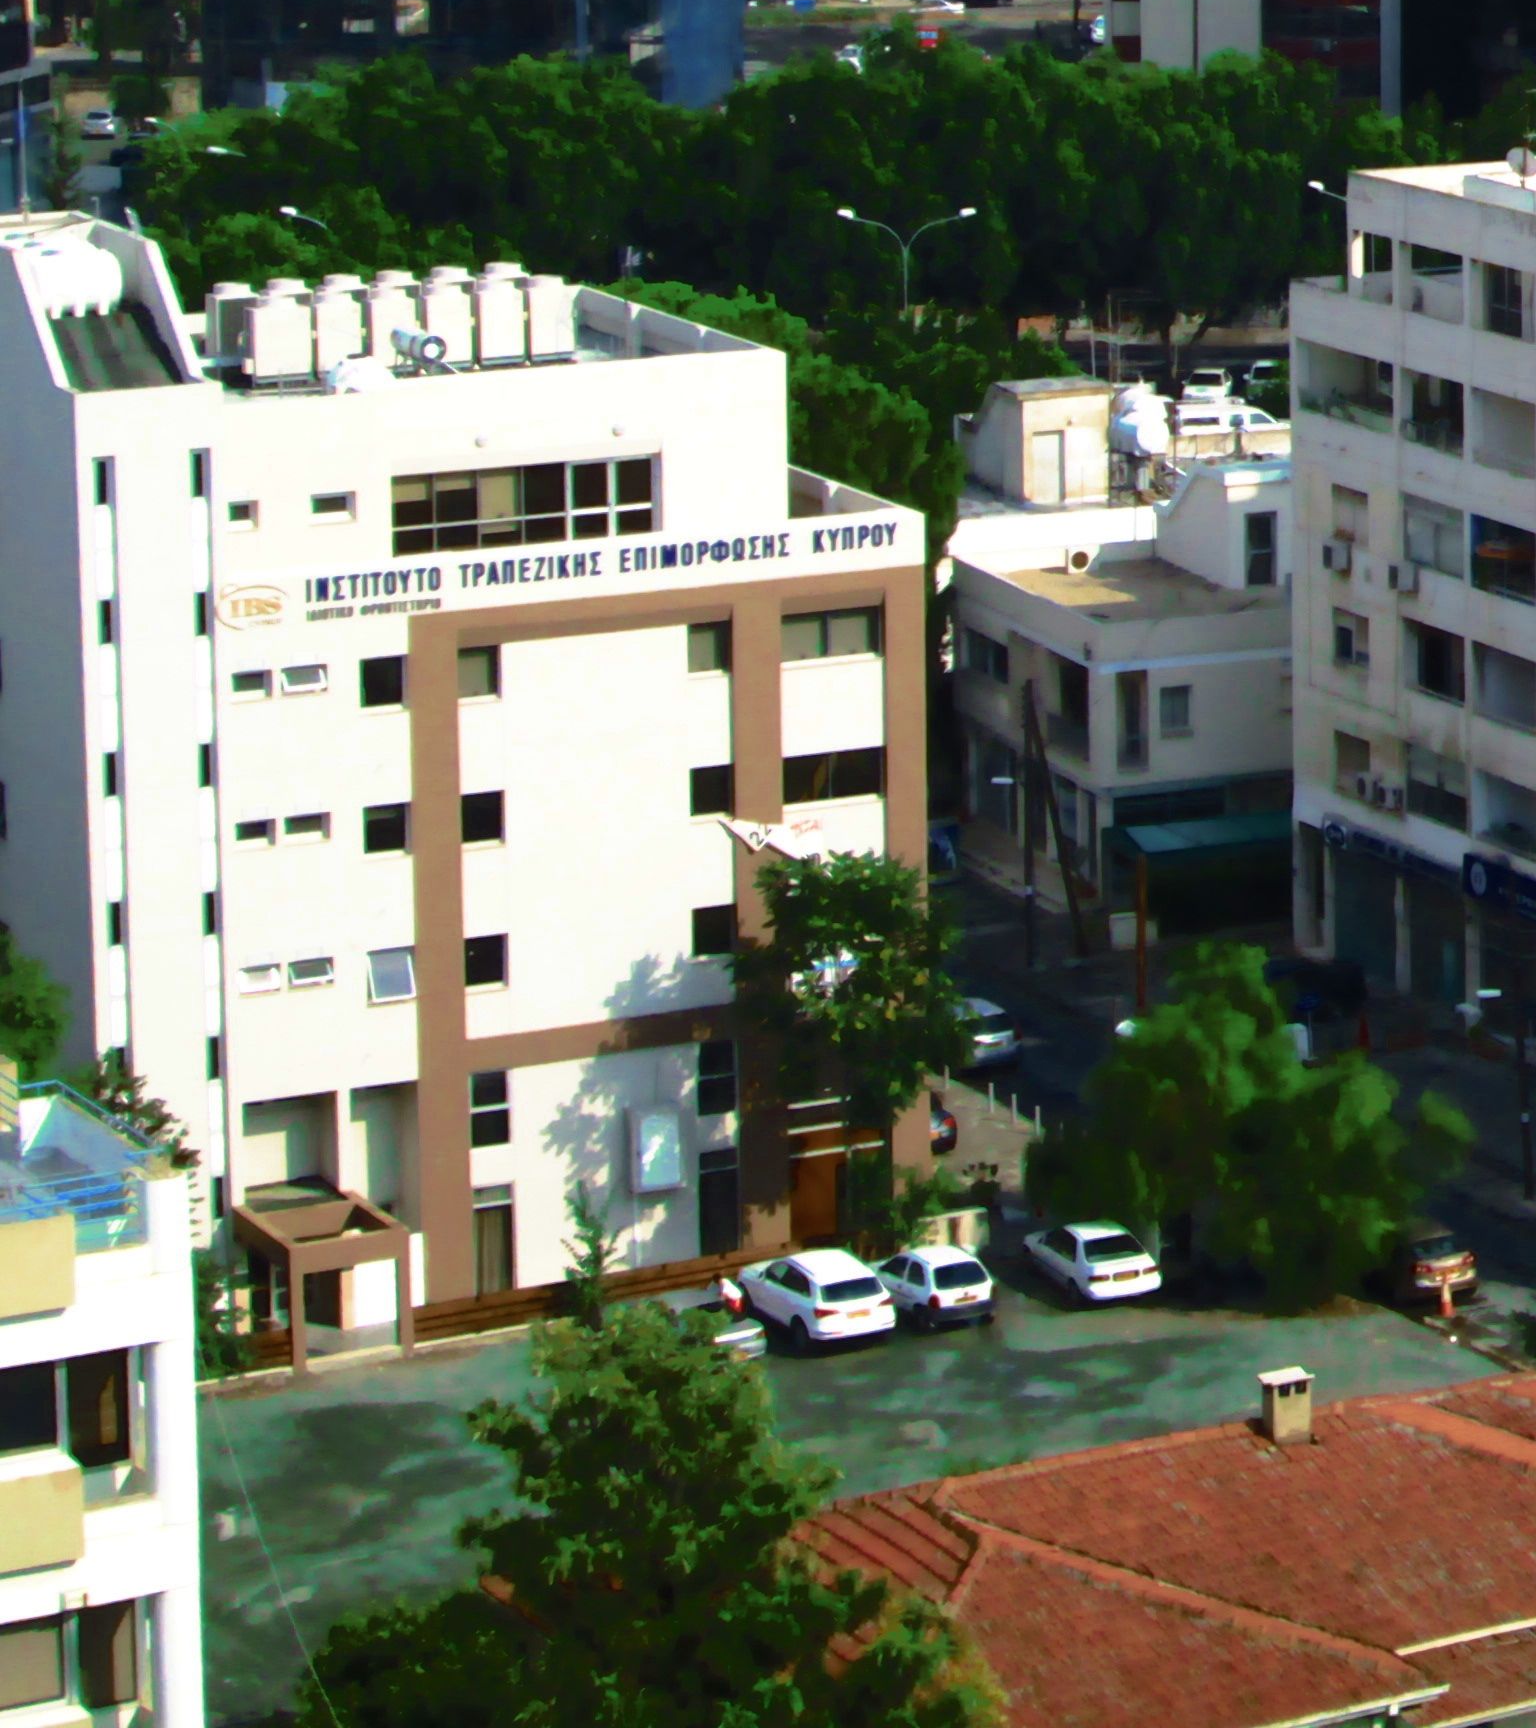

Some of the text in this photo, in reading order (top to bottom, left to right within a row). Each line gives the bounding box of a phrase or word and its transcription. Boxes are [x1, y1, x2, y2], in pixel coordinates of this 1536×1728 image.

[306, 523, 897, 603] ΙΝΣΤΙΤΟΥΤΟ ΤΡΑΠΕΖΙΚΗΣ ΕΠΙΜΟΡΦΩΣΗΣ ΚΥΠΡΟΥ
[231, 597, 282, 618] IBS
